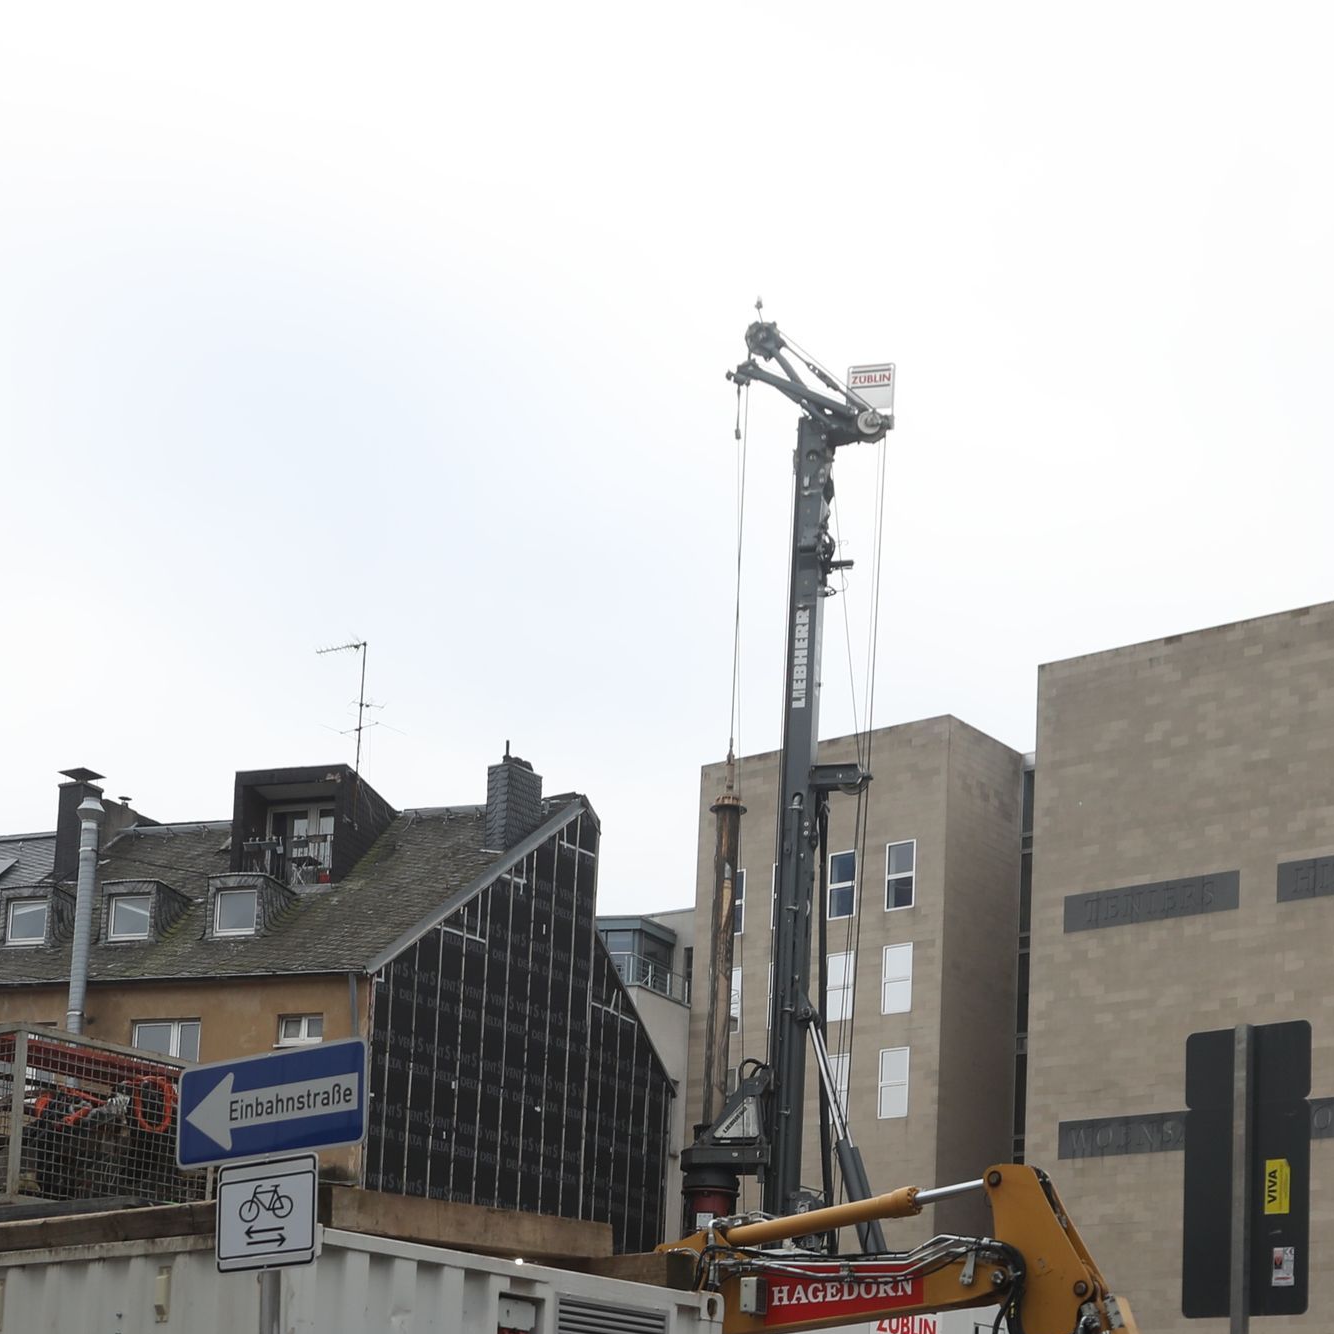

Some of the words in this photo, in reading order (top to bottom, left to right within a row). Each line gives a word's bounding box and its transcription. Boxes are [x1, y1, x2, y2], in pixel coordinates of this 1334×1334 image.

[792, 608, 810, 709] LIEBHERR
[229, 1083, 353, 1121] Einbahnstraße
[1267, 1169, 1278, 1204] VIVA
[772, 1275, 914, 1307] HAGEDORN
